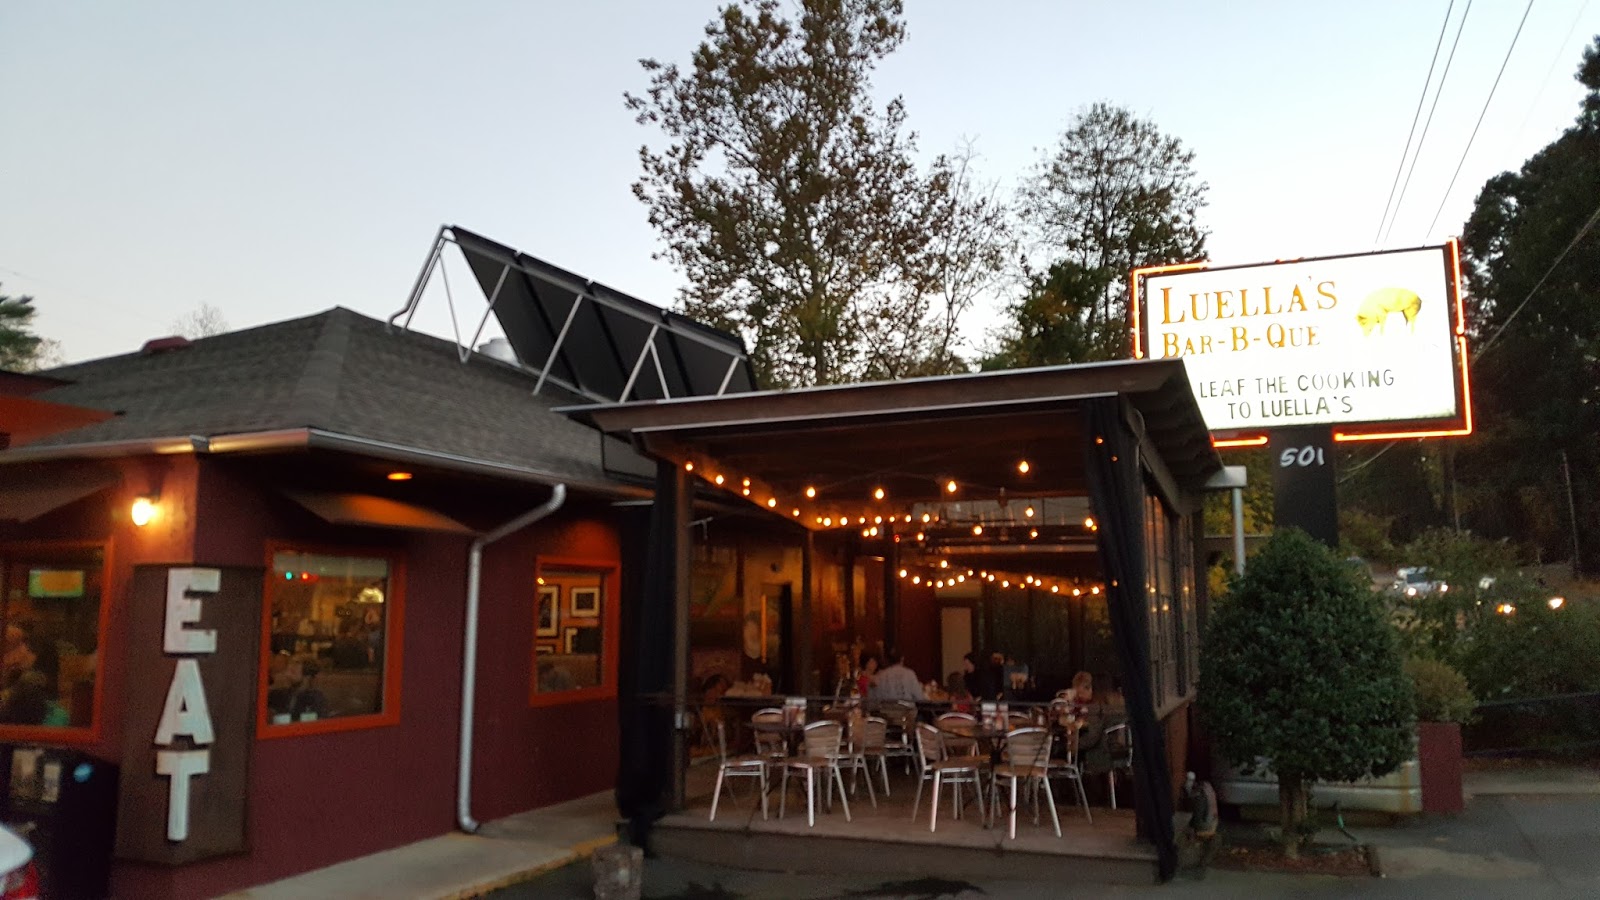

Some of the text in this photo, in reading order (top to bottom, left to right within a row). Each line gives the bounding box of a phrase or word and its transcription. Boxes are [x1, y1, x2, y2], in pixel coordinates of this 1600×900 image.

[1160, 276, 1337, 325] LUELLA'S
[1161, 323, 1321, 358] BAR-B-QUE
[1200, 369, 1395, 398] LEAF THE COOKING
[1228, 396, 1353, 420] TO LUELLA'S
[1279, 446, 1325, 468] 501
[154, 567, 222, 841] EAT
